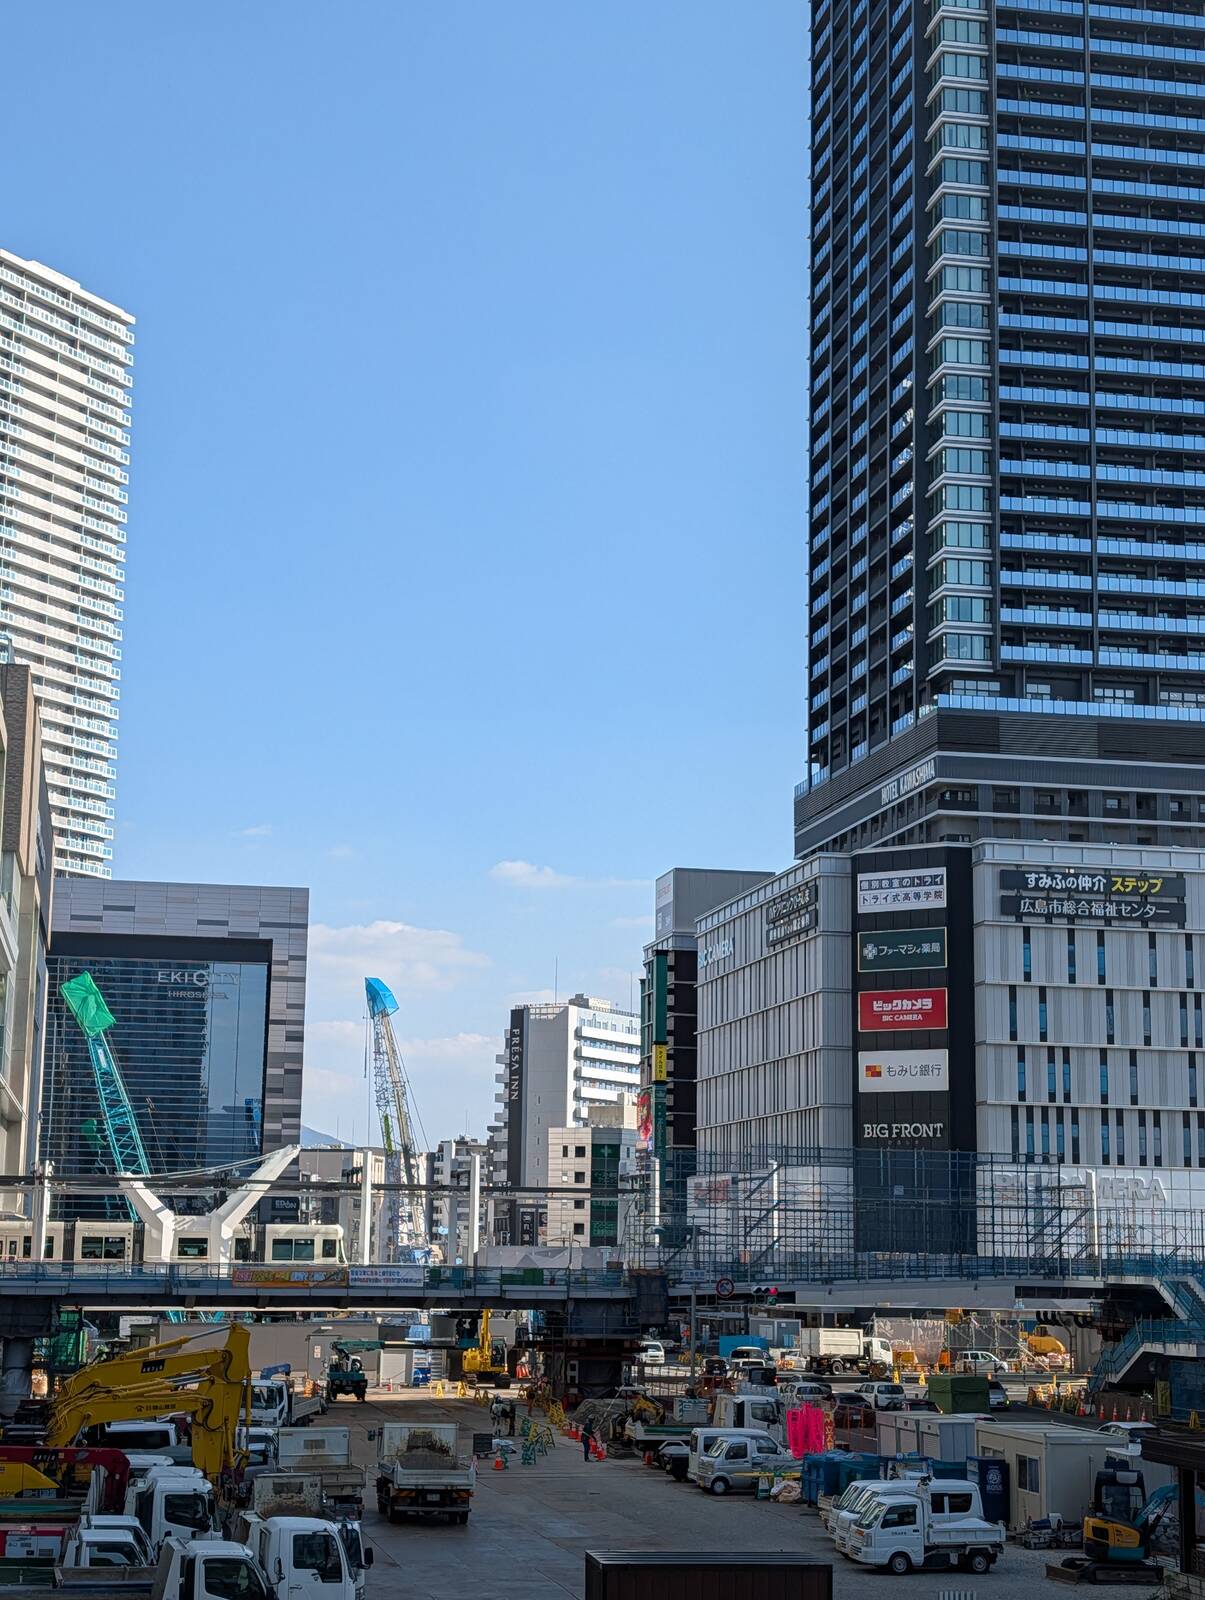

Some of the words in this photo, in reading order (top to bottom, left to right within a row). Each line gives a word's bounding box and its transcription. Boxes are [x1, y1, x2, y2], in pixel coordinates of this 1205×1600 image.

[881, 780, 899, 806] HOTEL
[861, 875, 942, 890] 個別教室のトライ
[1025, 873, 1107, 891] すみふの仲介
[1111, 877, 1163, 894] ステップ
[862, 890, 943, 904] トライ式高等学院
[1020, 898, 1170, 918] 広島市総合福祉センター
[878, 942, 941, 956] ファーマシィ薬局
[873, 998, 933, 1011] ビックカメラ
[882, 1014, 893, 1022] BIC
[894, 1013, 923, 1021] CAMERA
[886, 1064, 942, 1077] もみじ銀行
[510, 1076, 519, 1100] INN
[863, 1123, 889, 1138] BIG
[891, 1123, 944, 1138] FRONT
